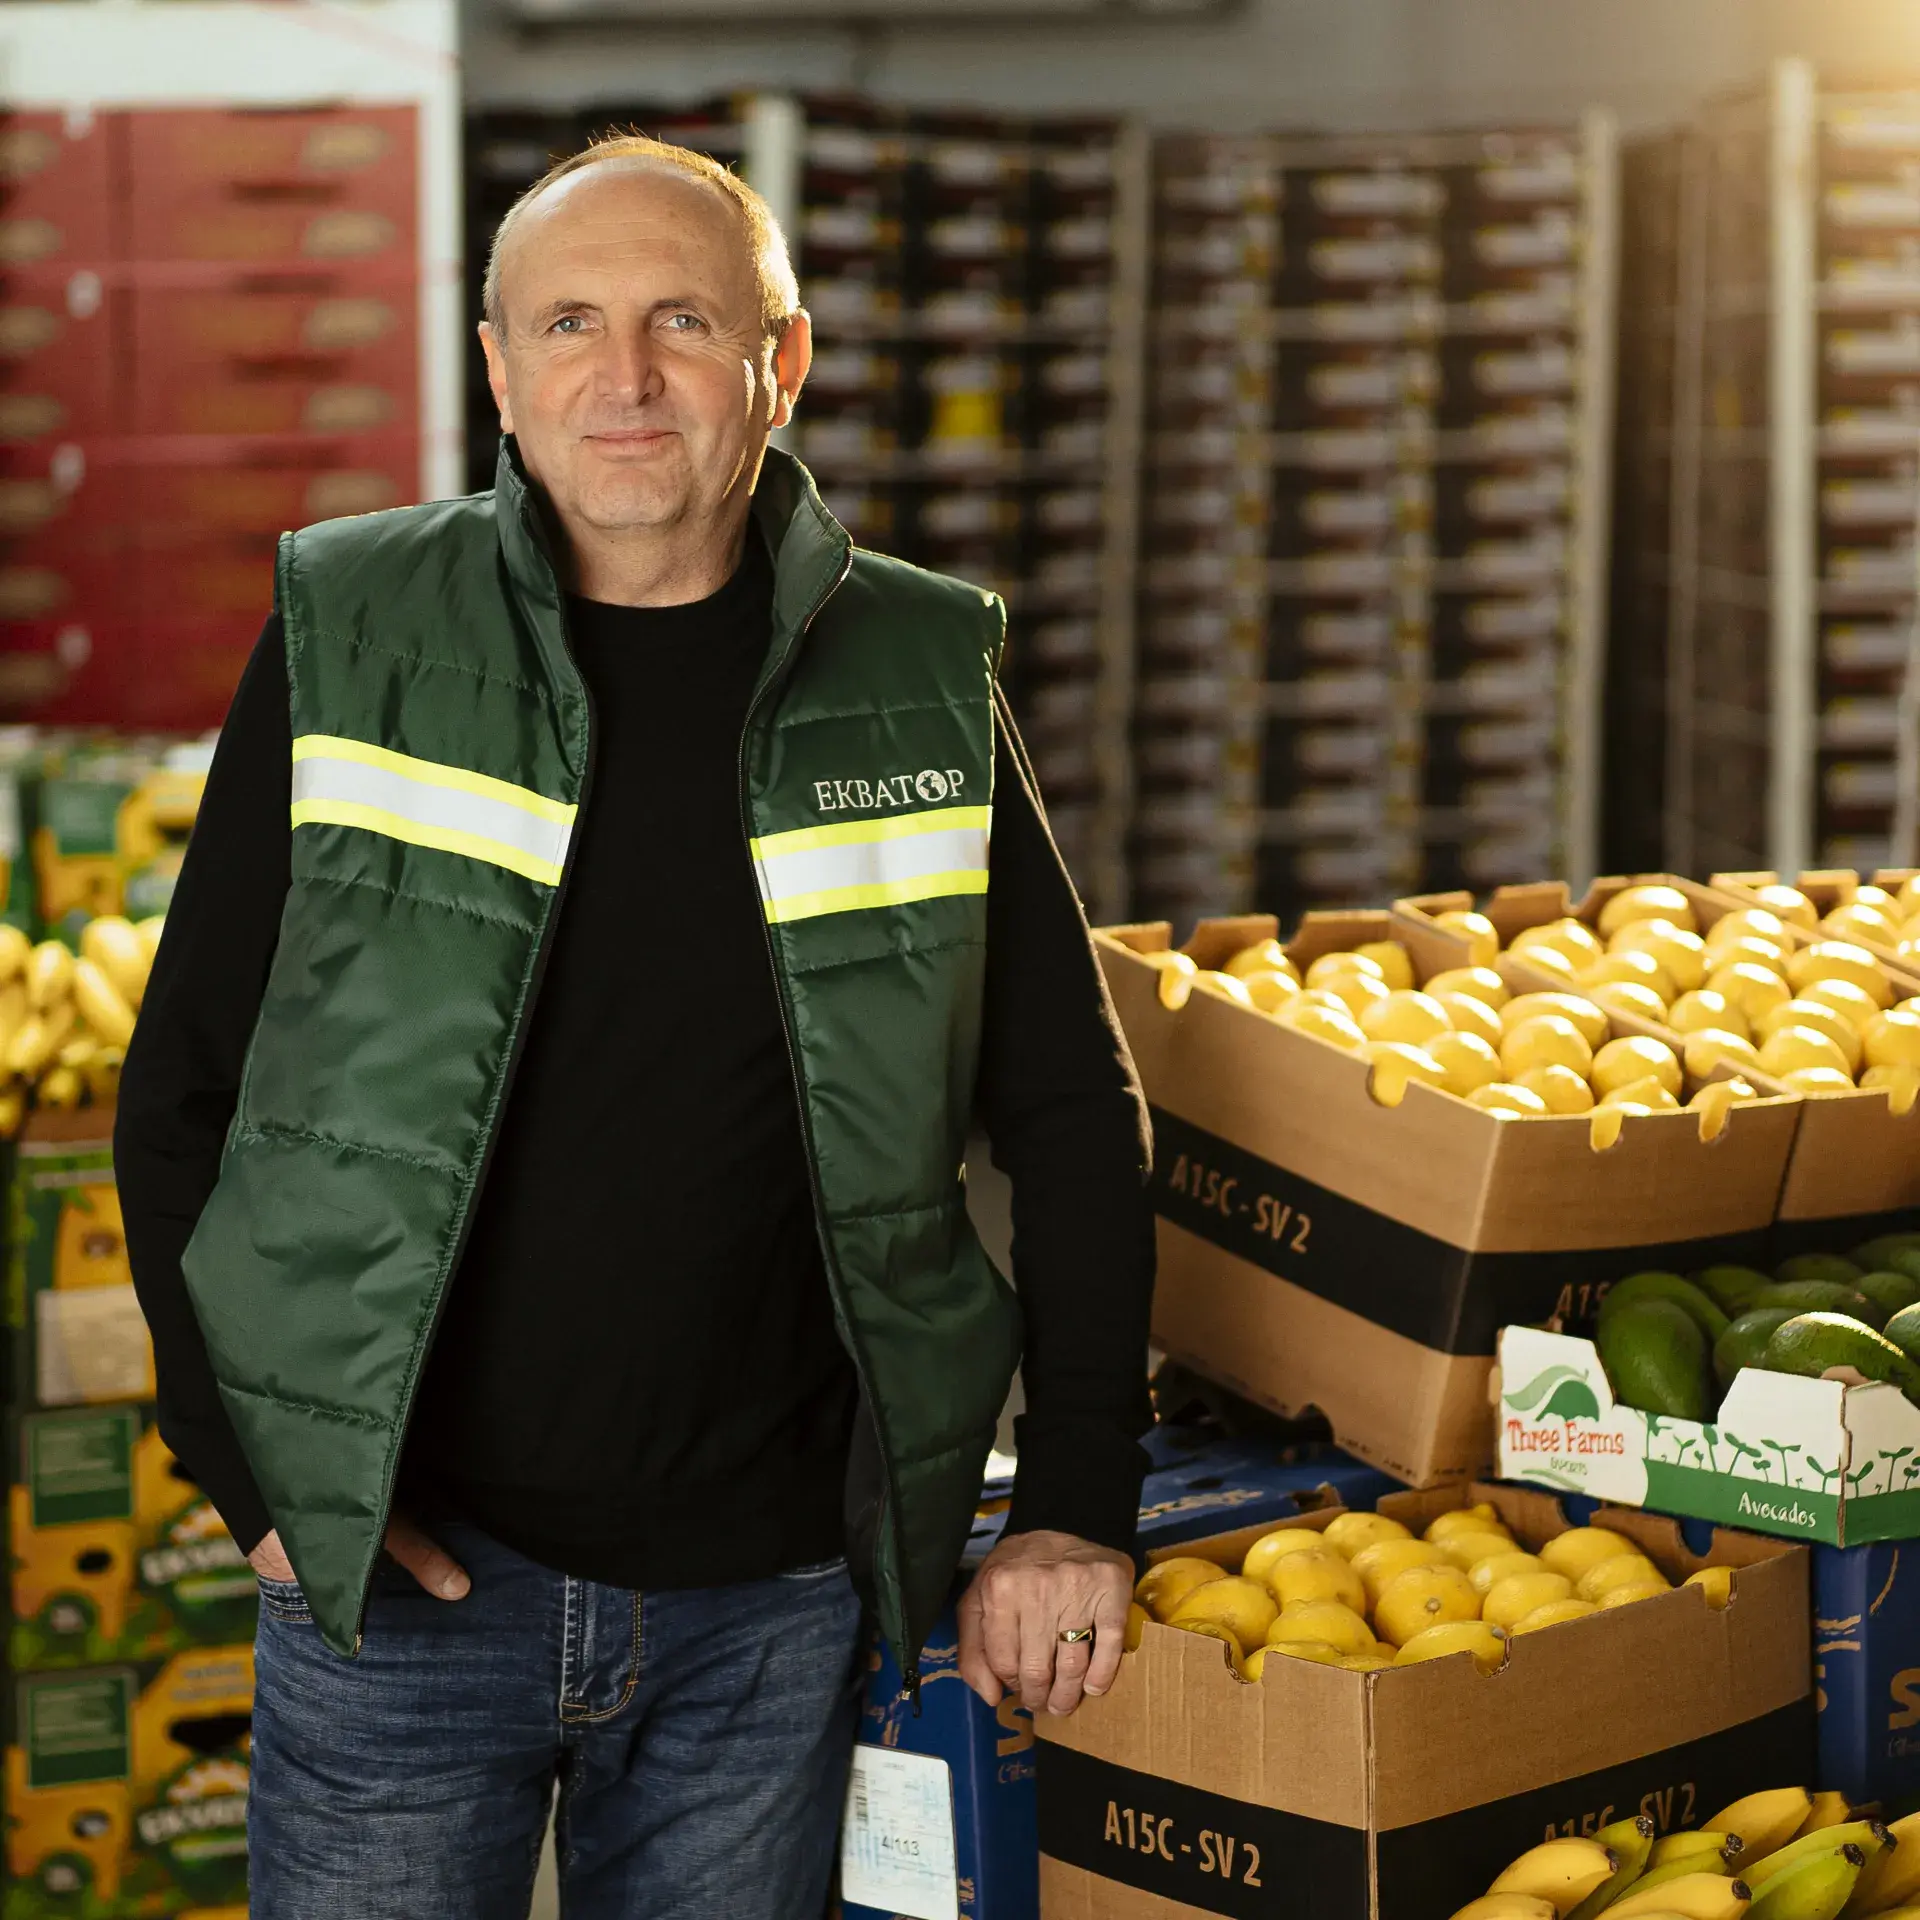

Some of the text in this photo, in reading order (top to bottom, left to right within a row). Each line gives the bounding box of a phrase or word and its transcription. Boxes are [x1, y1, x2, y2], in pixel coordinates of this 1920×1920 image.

[1507, 1419, 1625, 1455] Three Farms
[1737, 1491, 1816, 1528] Avocados
[1243, 1843, 1261, 1887] 2
